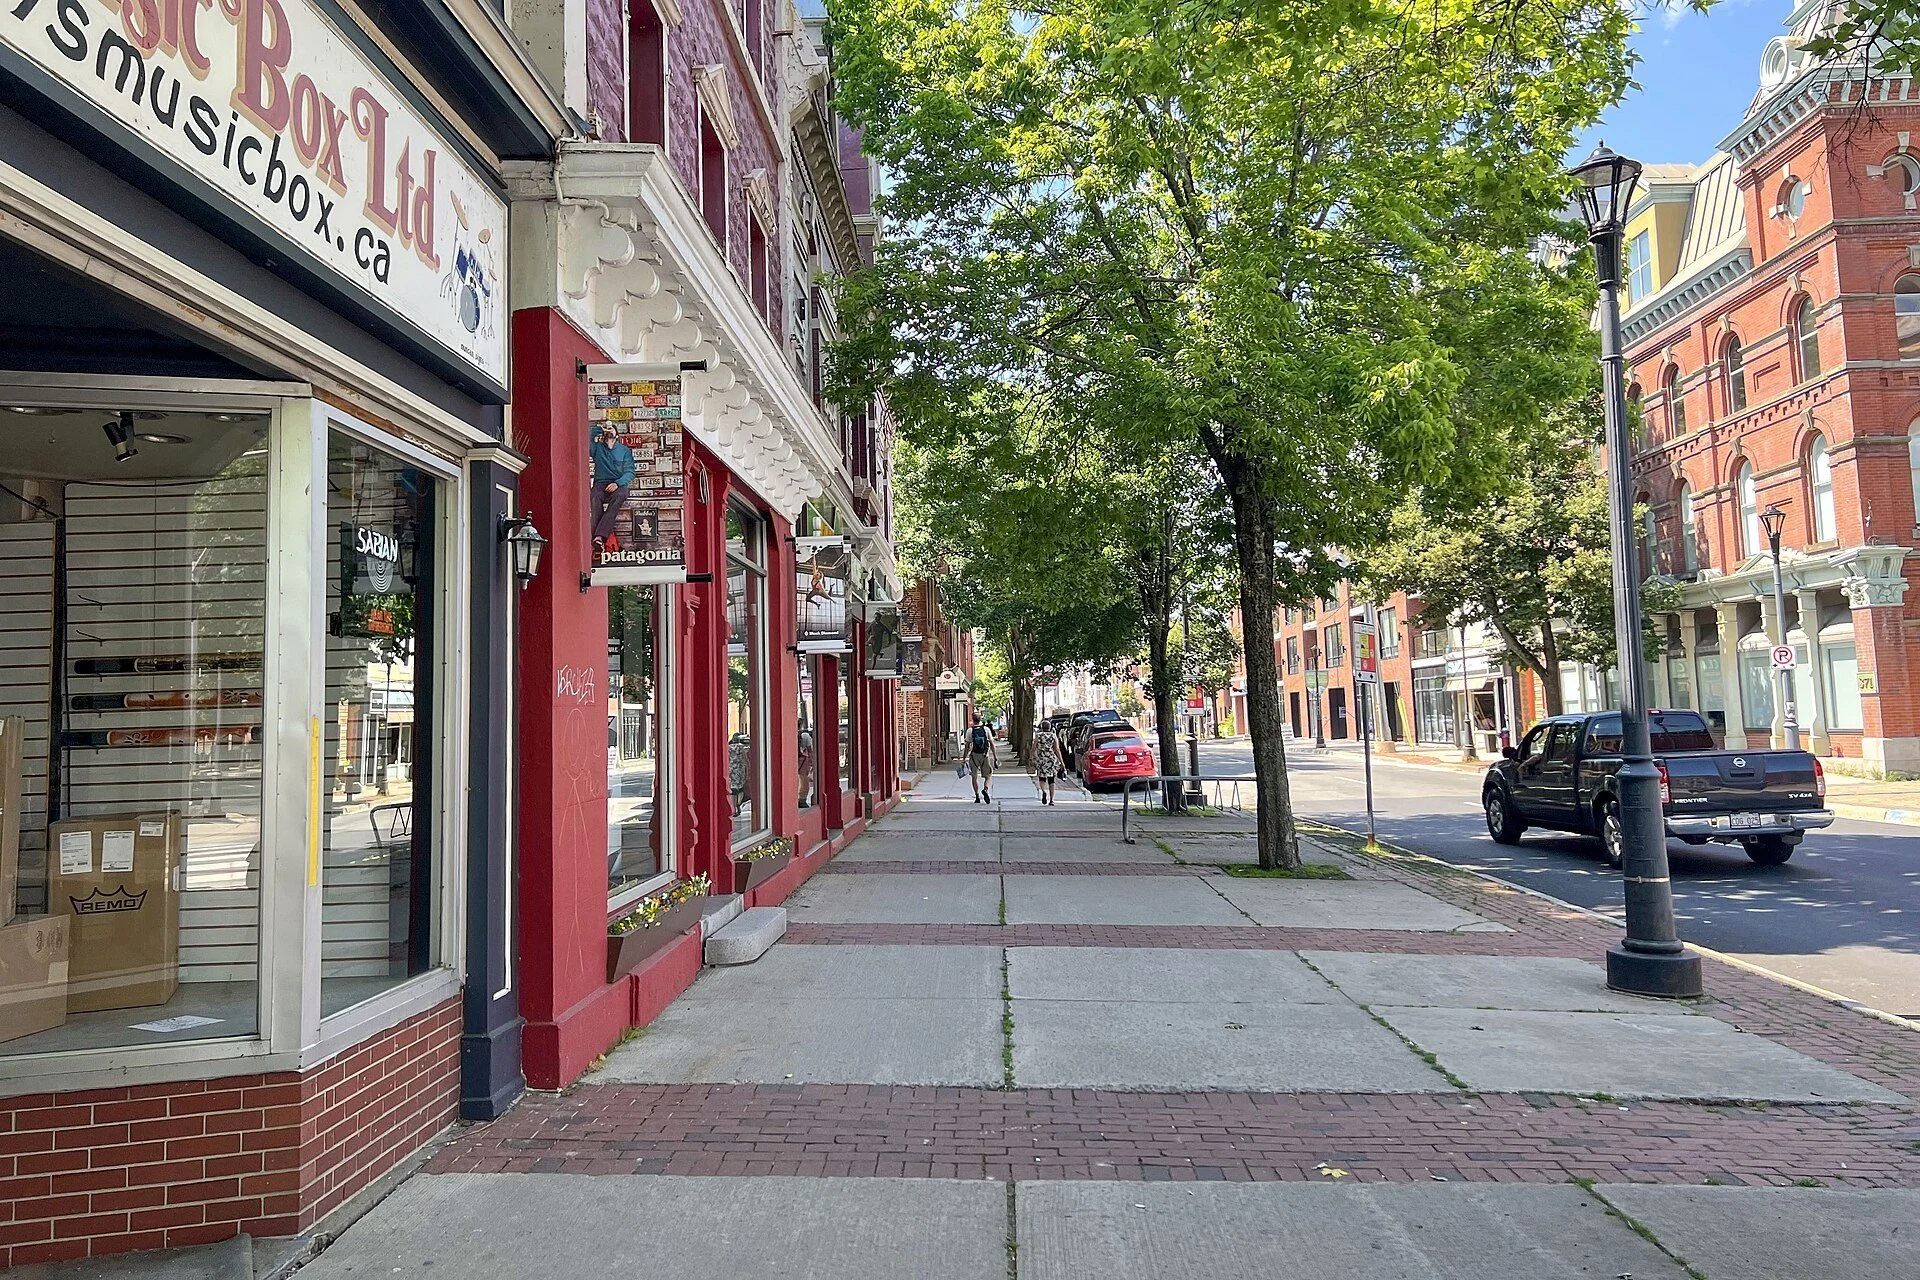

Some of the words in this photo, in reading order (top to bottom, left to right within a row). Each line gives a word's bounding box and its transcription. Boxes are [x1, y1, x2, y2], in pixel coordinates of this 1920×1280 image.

[219, 0, 349, 198] Box
[356, 527, 399, 563] SABIAN
[600, 547, 682, 565] patagonia
[81, 900, 137, 912] REMO
